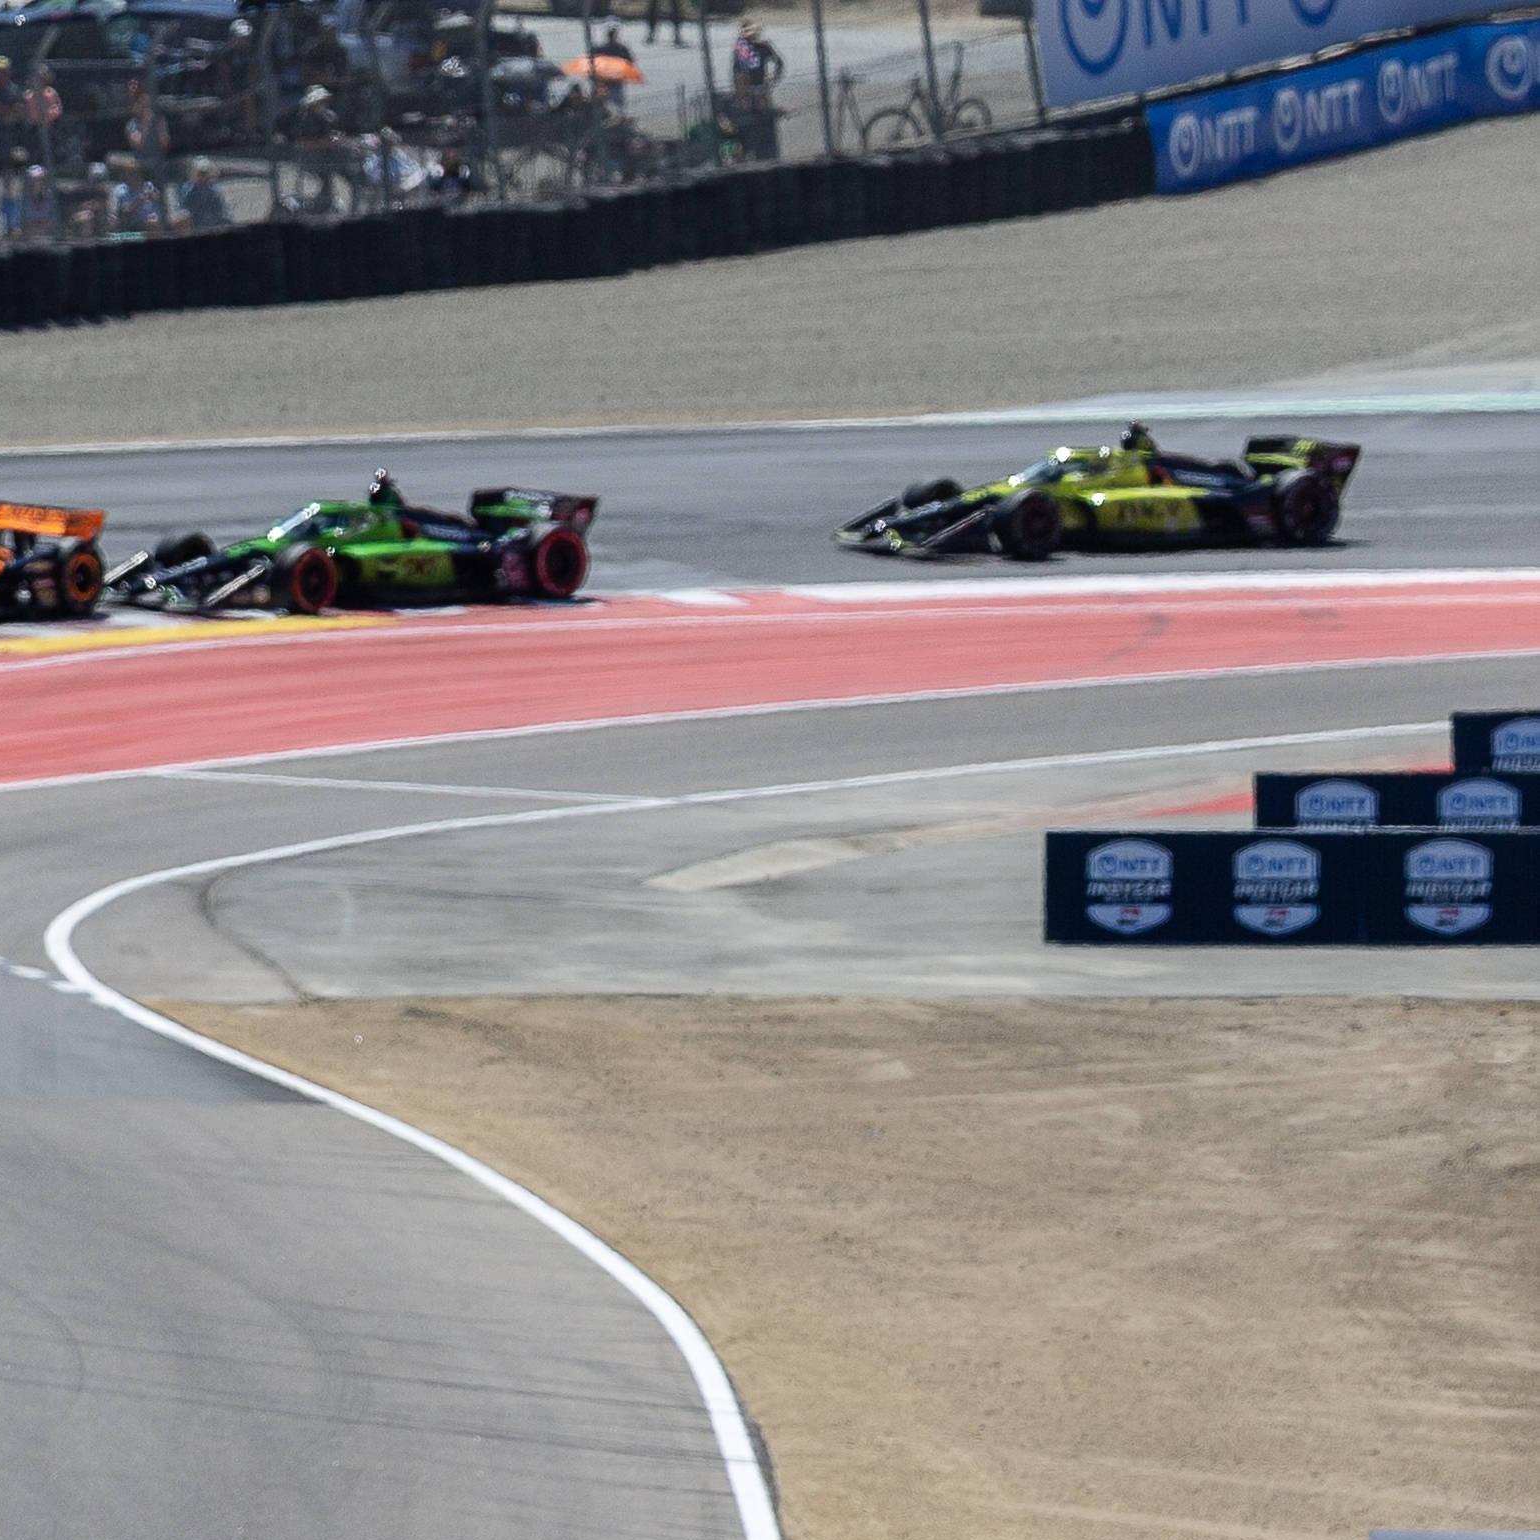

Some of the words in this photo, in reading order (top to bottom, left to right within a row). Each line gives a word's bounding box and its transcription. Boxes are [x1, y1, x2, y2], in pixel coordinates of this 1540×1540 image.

[1304, 79, 1362, 138] NTT
[1407, 51, 1459, 113] NTT
[1202, 106, 1261, 162] NTT
